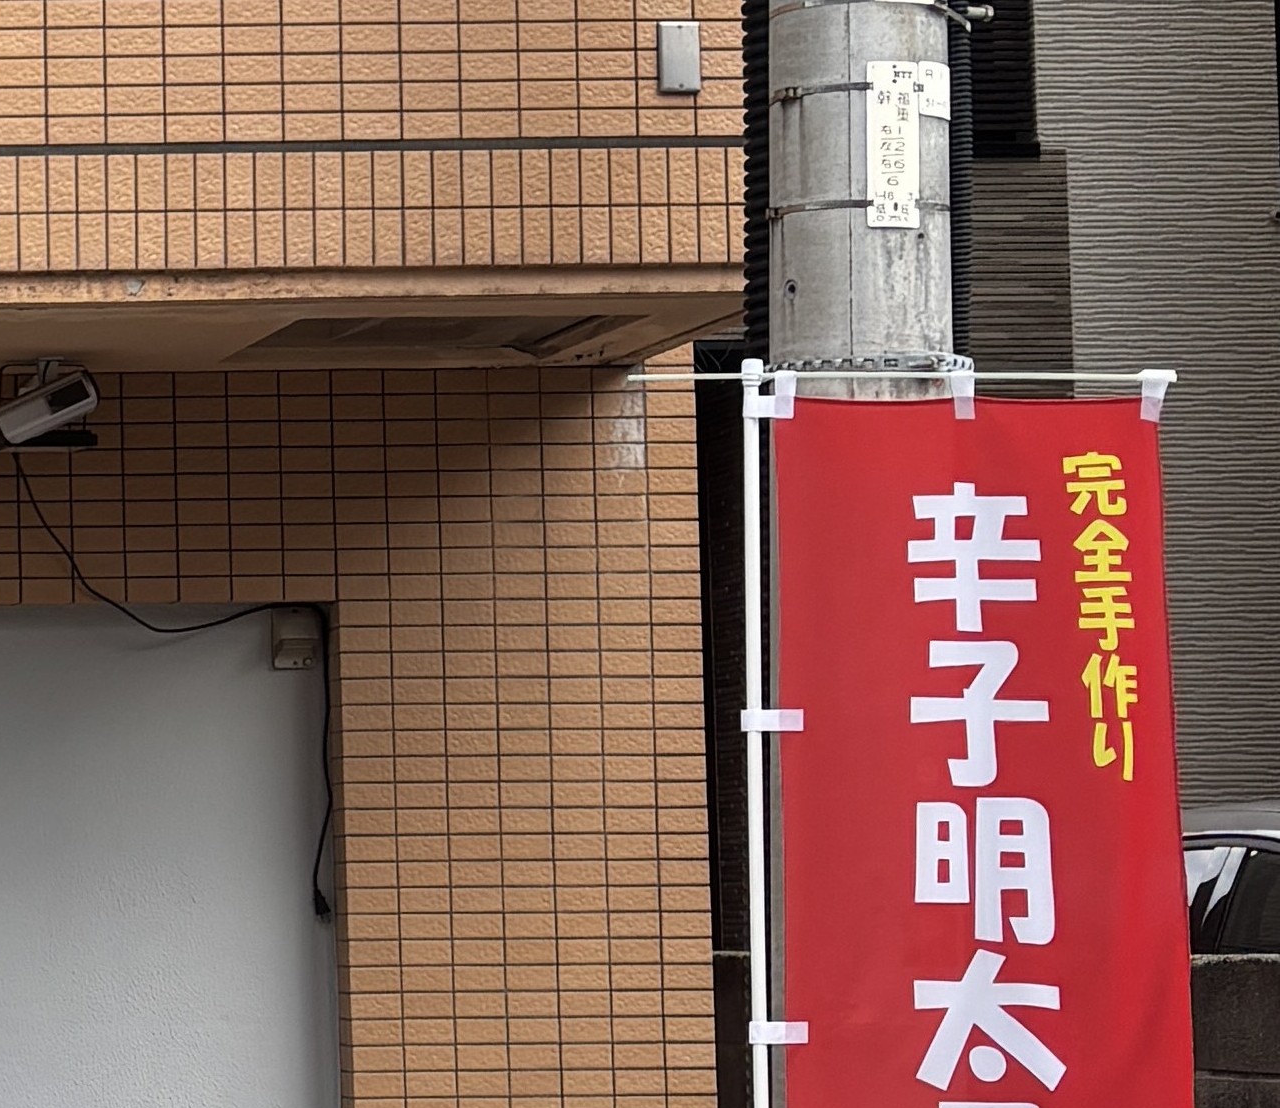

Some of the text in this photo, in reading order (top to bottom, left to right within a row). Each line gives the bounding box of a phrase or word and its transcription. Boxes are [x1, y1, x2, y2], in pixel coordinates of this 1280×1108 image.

[1062, 451, 1139, 781] 完全手作り
